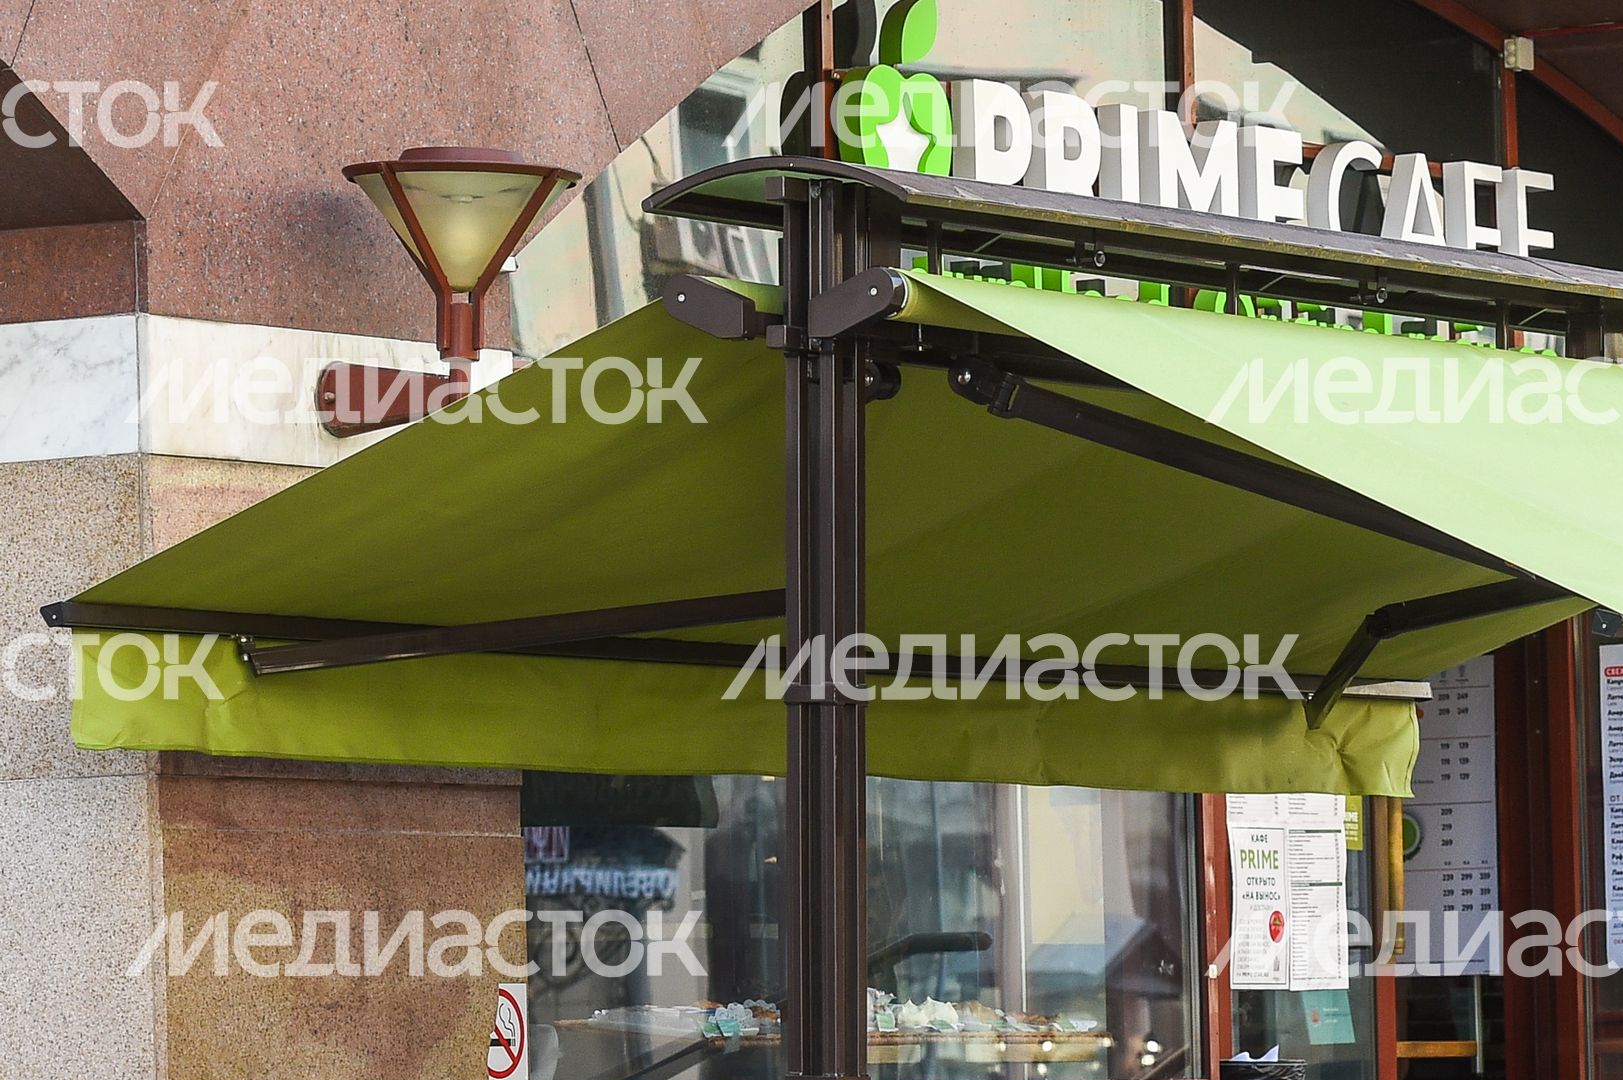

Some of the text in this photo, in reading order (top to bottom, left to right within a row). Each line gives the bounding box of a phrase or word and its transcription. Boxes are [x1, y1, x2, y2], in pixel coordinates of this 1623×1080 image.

[953, 78, 1554, 256] PRIME CAFE
[1251, 834, 1268, 843] КАФЕ
[1240, 849, 1279, 870] PRIME
[1246, 877, 1276, 886] ОТКРЫТО
